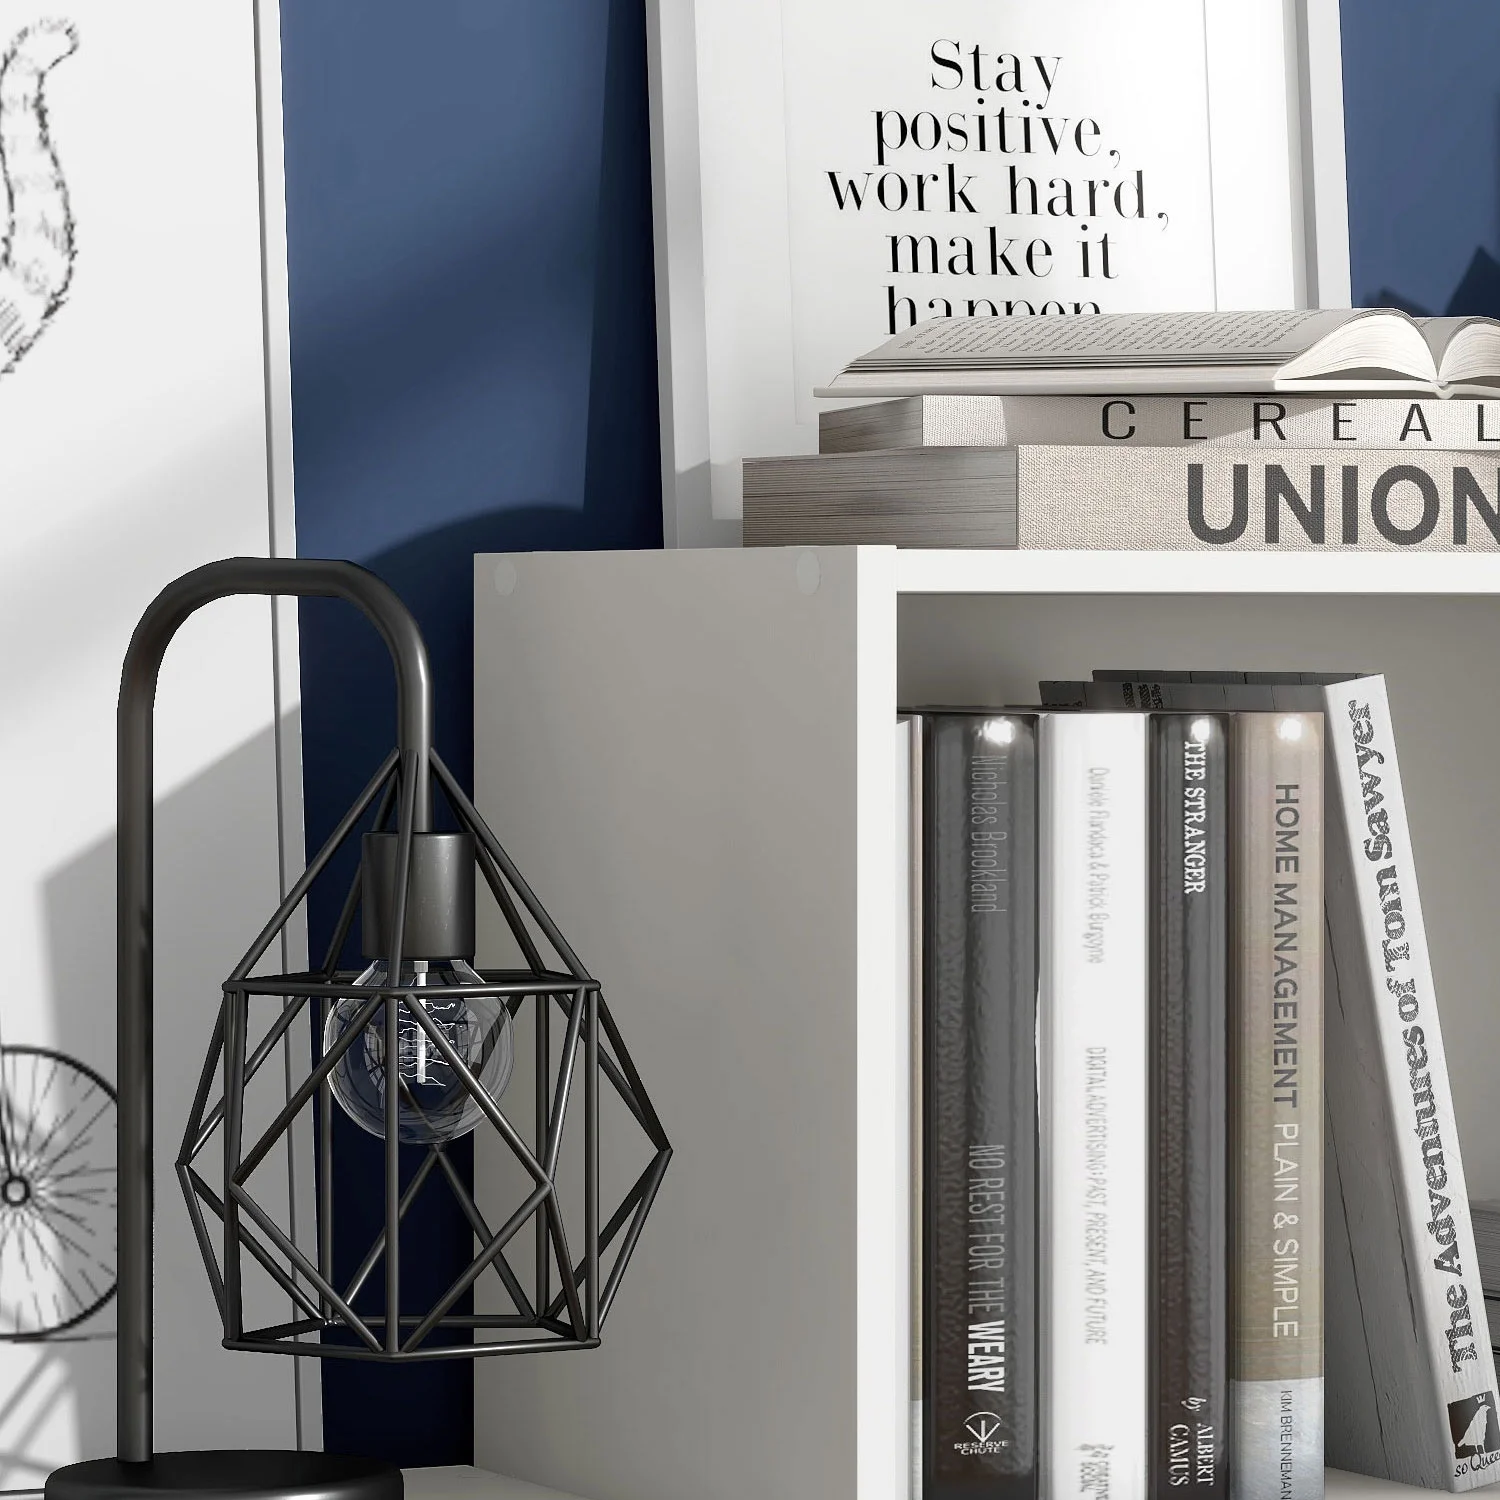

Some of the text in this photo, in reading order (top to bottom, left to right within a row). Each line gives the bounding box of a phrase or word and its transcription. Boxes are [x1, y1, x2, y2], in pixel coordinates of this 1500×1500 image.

[931, 38, 1064, 110] Stay
[870, 97, 1121, 168] positive,
[824, 163, 1169, 231] work hard,
[885, 224, 1120, 279] make it
[971, 755, 1008, 913] Nicholas Brookland
[1184, 738, 1207, 894] THE STRANGER
[1089, 861, 1111, 872] &
[1273, 784, 1300, 1338] HOME MANAGEMENT PLAIN & SIMPLE
[1348, 699, 1479, 1374] The Adventures of Tom Sawyer
[968, 1145, 1005, 1392] NO REST FOR THE WEARY
[1085, 1298, 1107, 1345] FUTURE
[1181, 1396, 1207, 1412] by
[954, 1440, 1009, 1450] RESERVE
[1169, 1423, 1190, 1486] CAMUS
[1197, 1423, 1215, 1486] ALBERT
[1280, 1390, 1293, 1500] KIM BRENNEMAN
